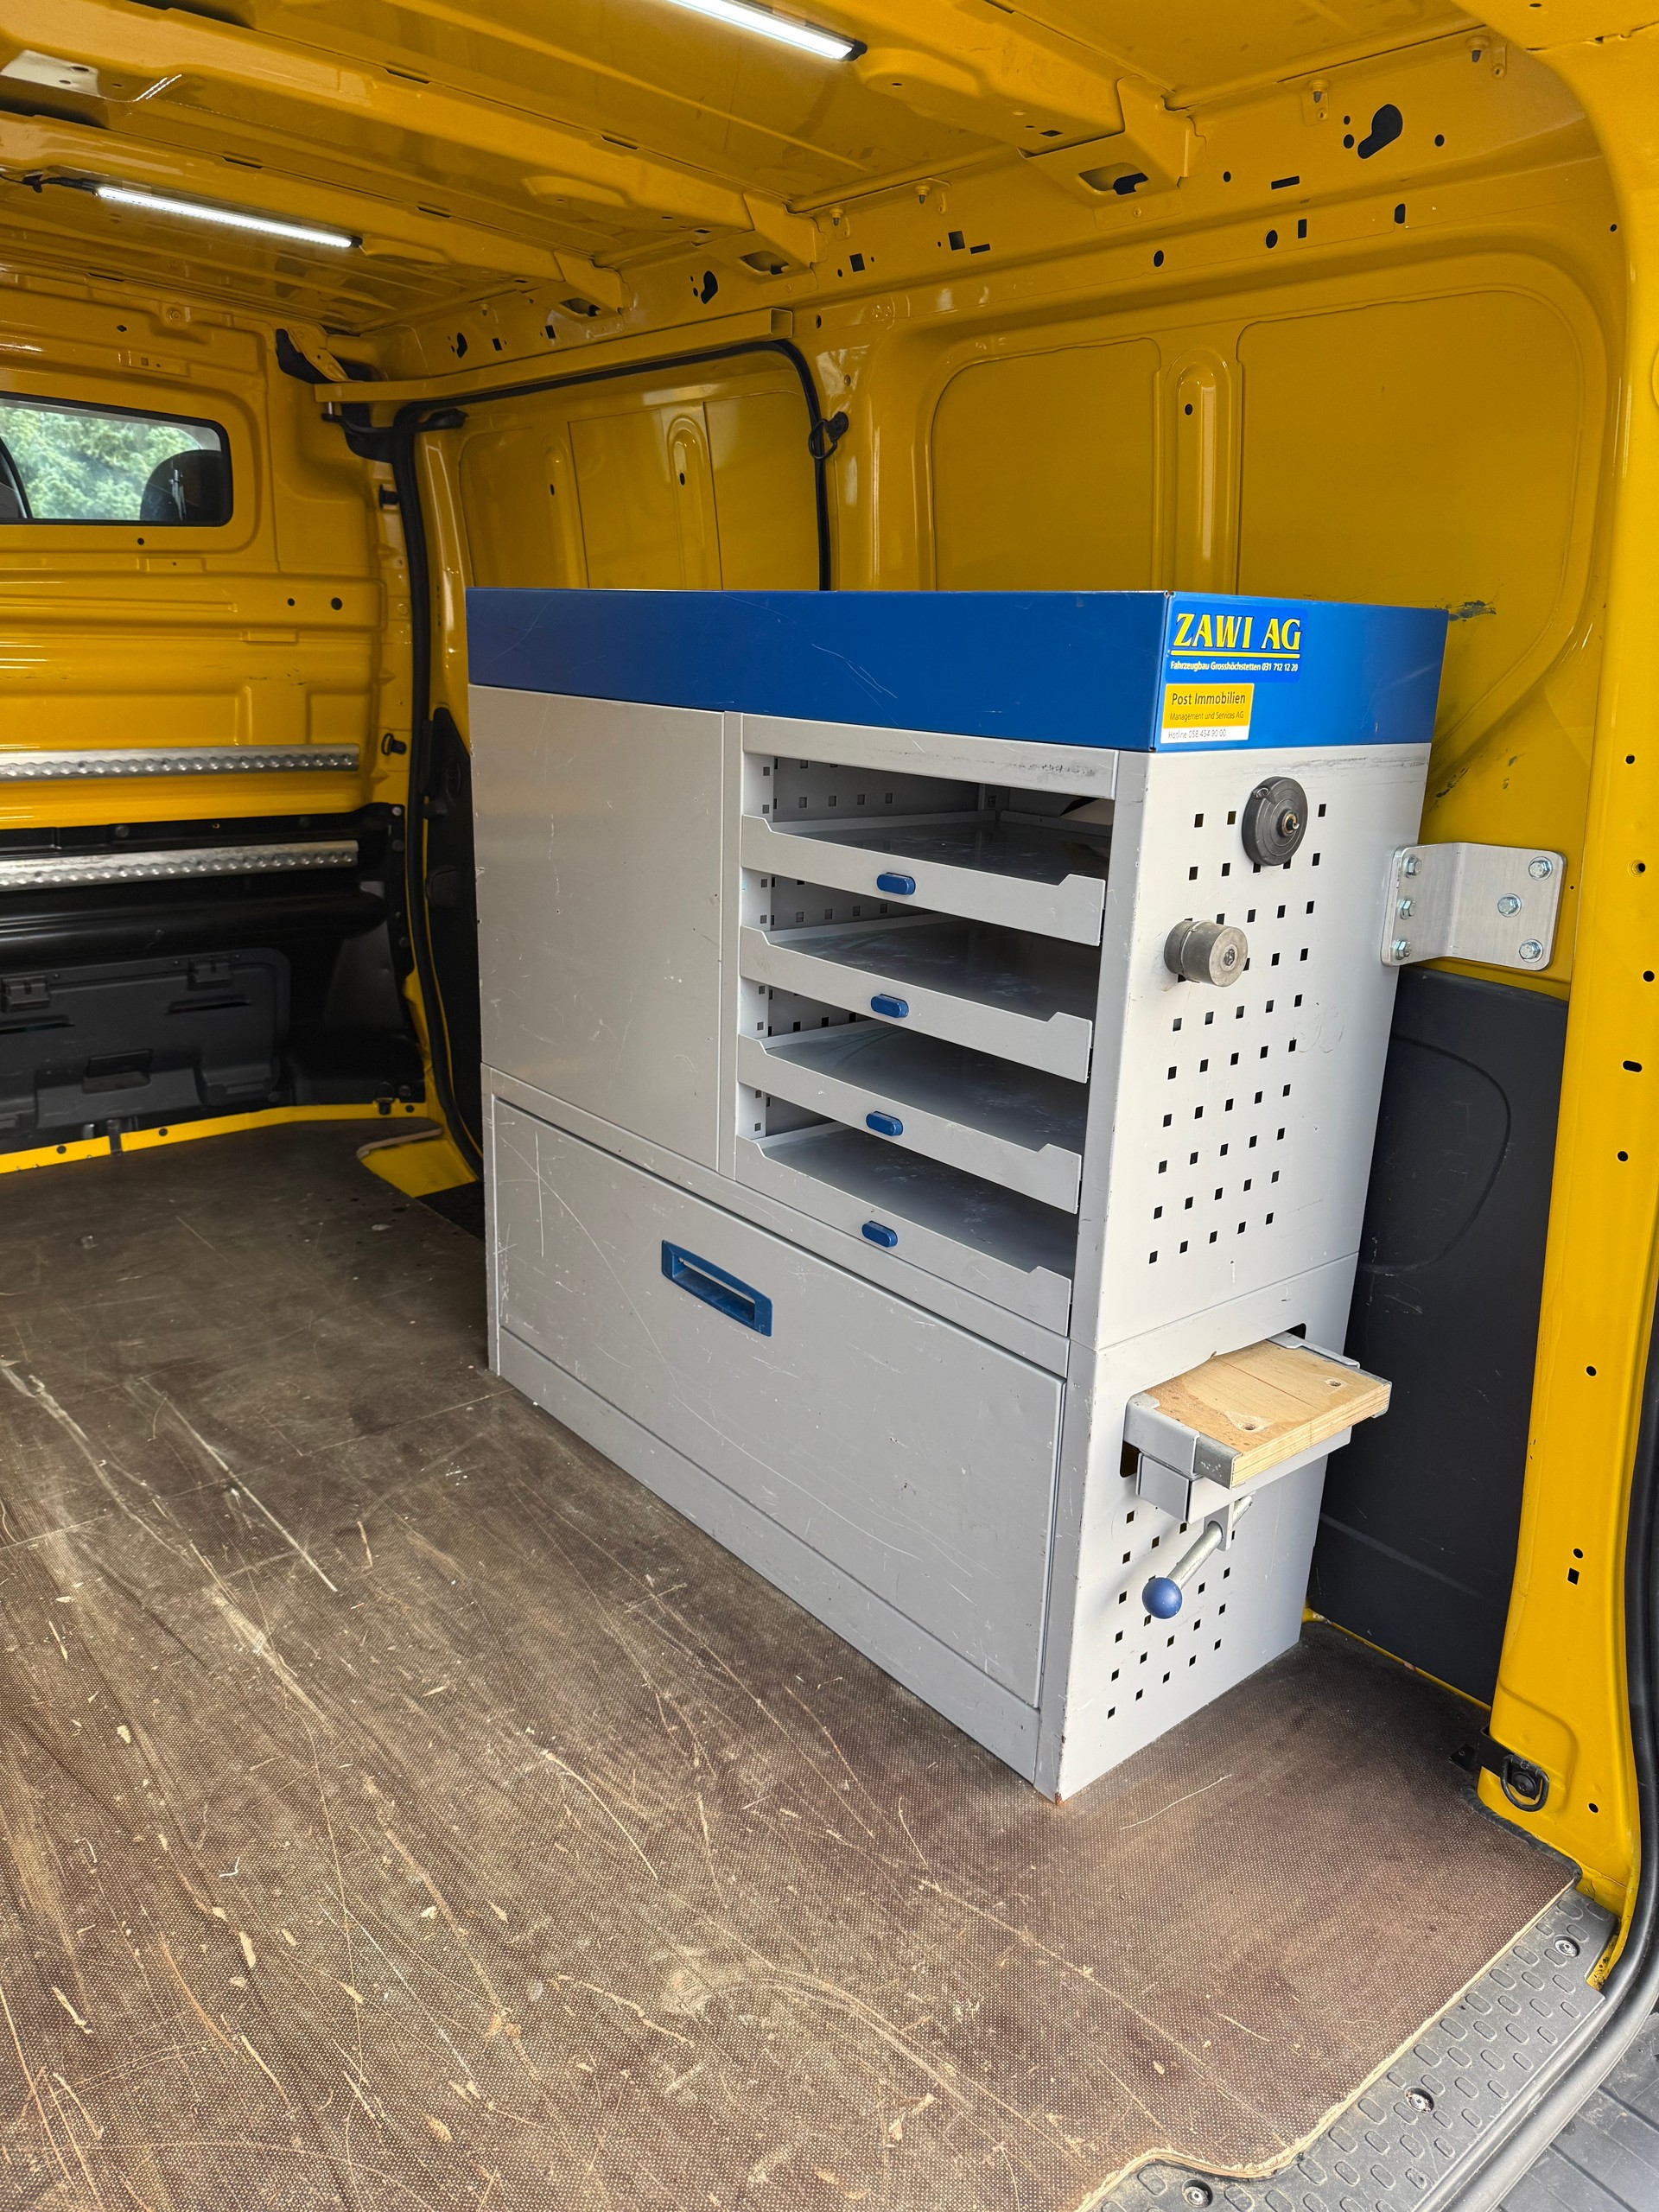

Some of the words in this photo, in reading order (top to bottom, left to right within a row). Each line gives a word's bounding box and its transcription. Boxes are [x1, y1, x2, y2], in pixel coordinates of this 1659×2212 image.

[1173, 613, 1253, 649] ZAWI
[1261, 618, 1302, 650] AG
[1170, 660, 1210, 672] Fahrzeugbau
[1262, 662, 1272, 671] 031
[1274, 663, 1283, 671] 712
[1284, 663, 1291, 671] 12
[1291, 663, 1299, 672] 20
[1172, 693, 1192, 705] Post
[1194, 691, 1246, 705] Immobilien
[1170, 713, 1204, 721] Management
[1205, 711, 1215, 720] und
[1216, 710, 1235, 719] Services
[1236, 710, 1244, 719] AG
[1168, 730, 1187, 739] Hotline
